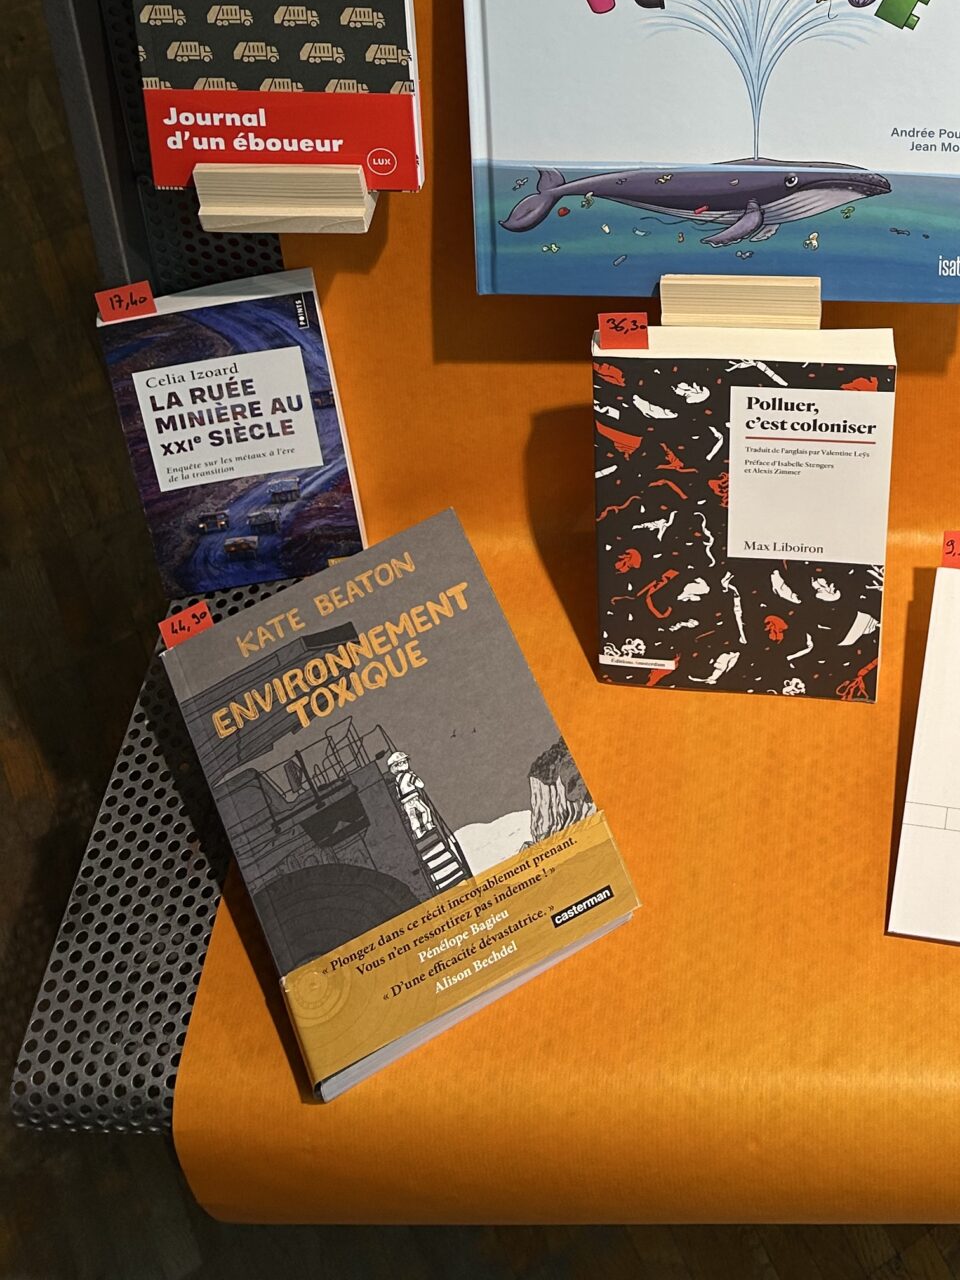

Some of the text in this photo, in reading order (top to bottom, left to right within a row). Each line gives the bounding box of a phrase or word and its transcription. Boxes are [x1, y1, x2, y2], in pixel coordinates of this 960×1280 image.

[163, 107, 266, 128] Journal
[167, 131, 344, 153] d'un éboueur
[890, 126, 936, 139] Andrée
[910, 141, 938, 152] Jean
[372, 157, 391, 166] LUX
[295, 299, 307, 326] POINTS
[145, 362, 240, 389] Celia Izoard
[149, 375, 257, 412] LA RUÉE
[746, 395, 820, 416] Polluer,
[155, 393, 304, 434] MINIÈRE AU
[745, 417, 877, 435] c'est coloniser
[208, 416, 296, 448] SIÈCLE
[743, 540, 824, 554] Max Liboiron
[236, 552, 416, 658] KATE BEATON
[211, 581, 469, 739] ENVIRONNEMENT
[286, 640, 428, 729] TOXIQUE
[553, 886, 611, 926] casterman
